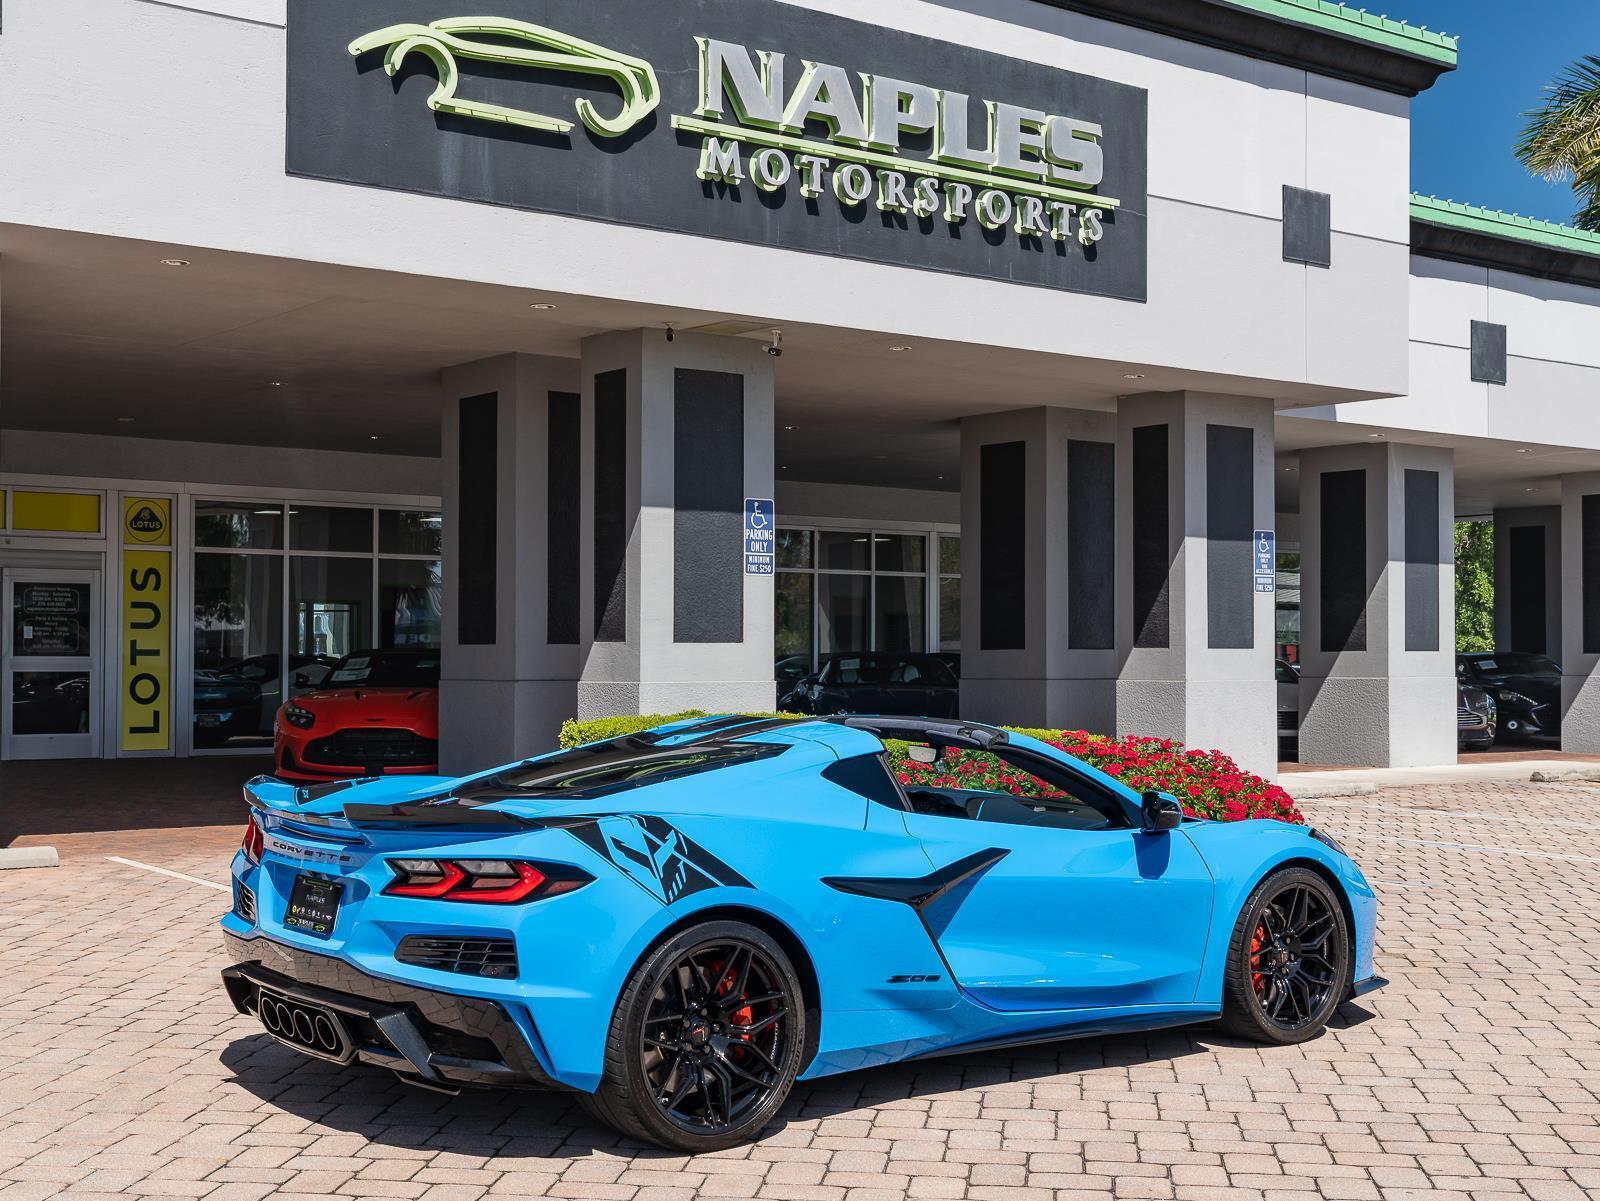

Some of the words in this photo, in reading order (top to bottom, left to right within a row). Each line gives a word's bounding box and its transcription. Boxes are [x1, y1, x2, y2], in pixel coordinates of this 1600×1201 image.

[693, 36, 1104, 189] NAPLES
[696, 136, 1104, 245] MOTORSPORTS
[132, 520, 161, 529] LOTUS
[745, 528, 773, 541] PARKING
[750, 541, 768, 552] ONLY
[129, 567, 162, 734] LOTUS
[272, 841, 351, 862] CORVETTE
